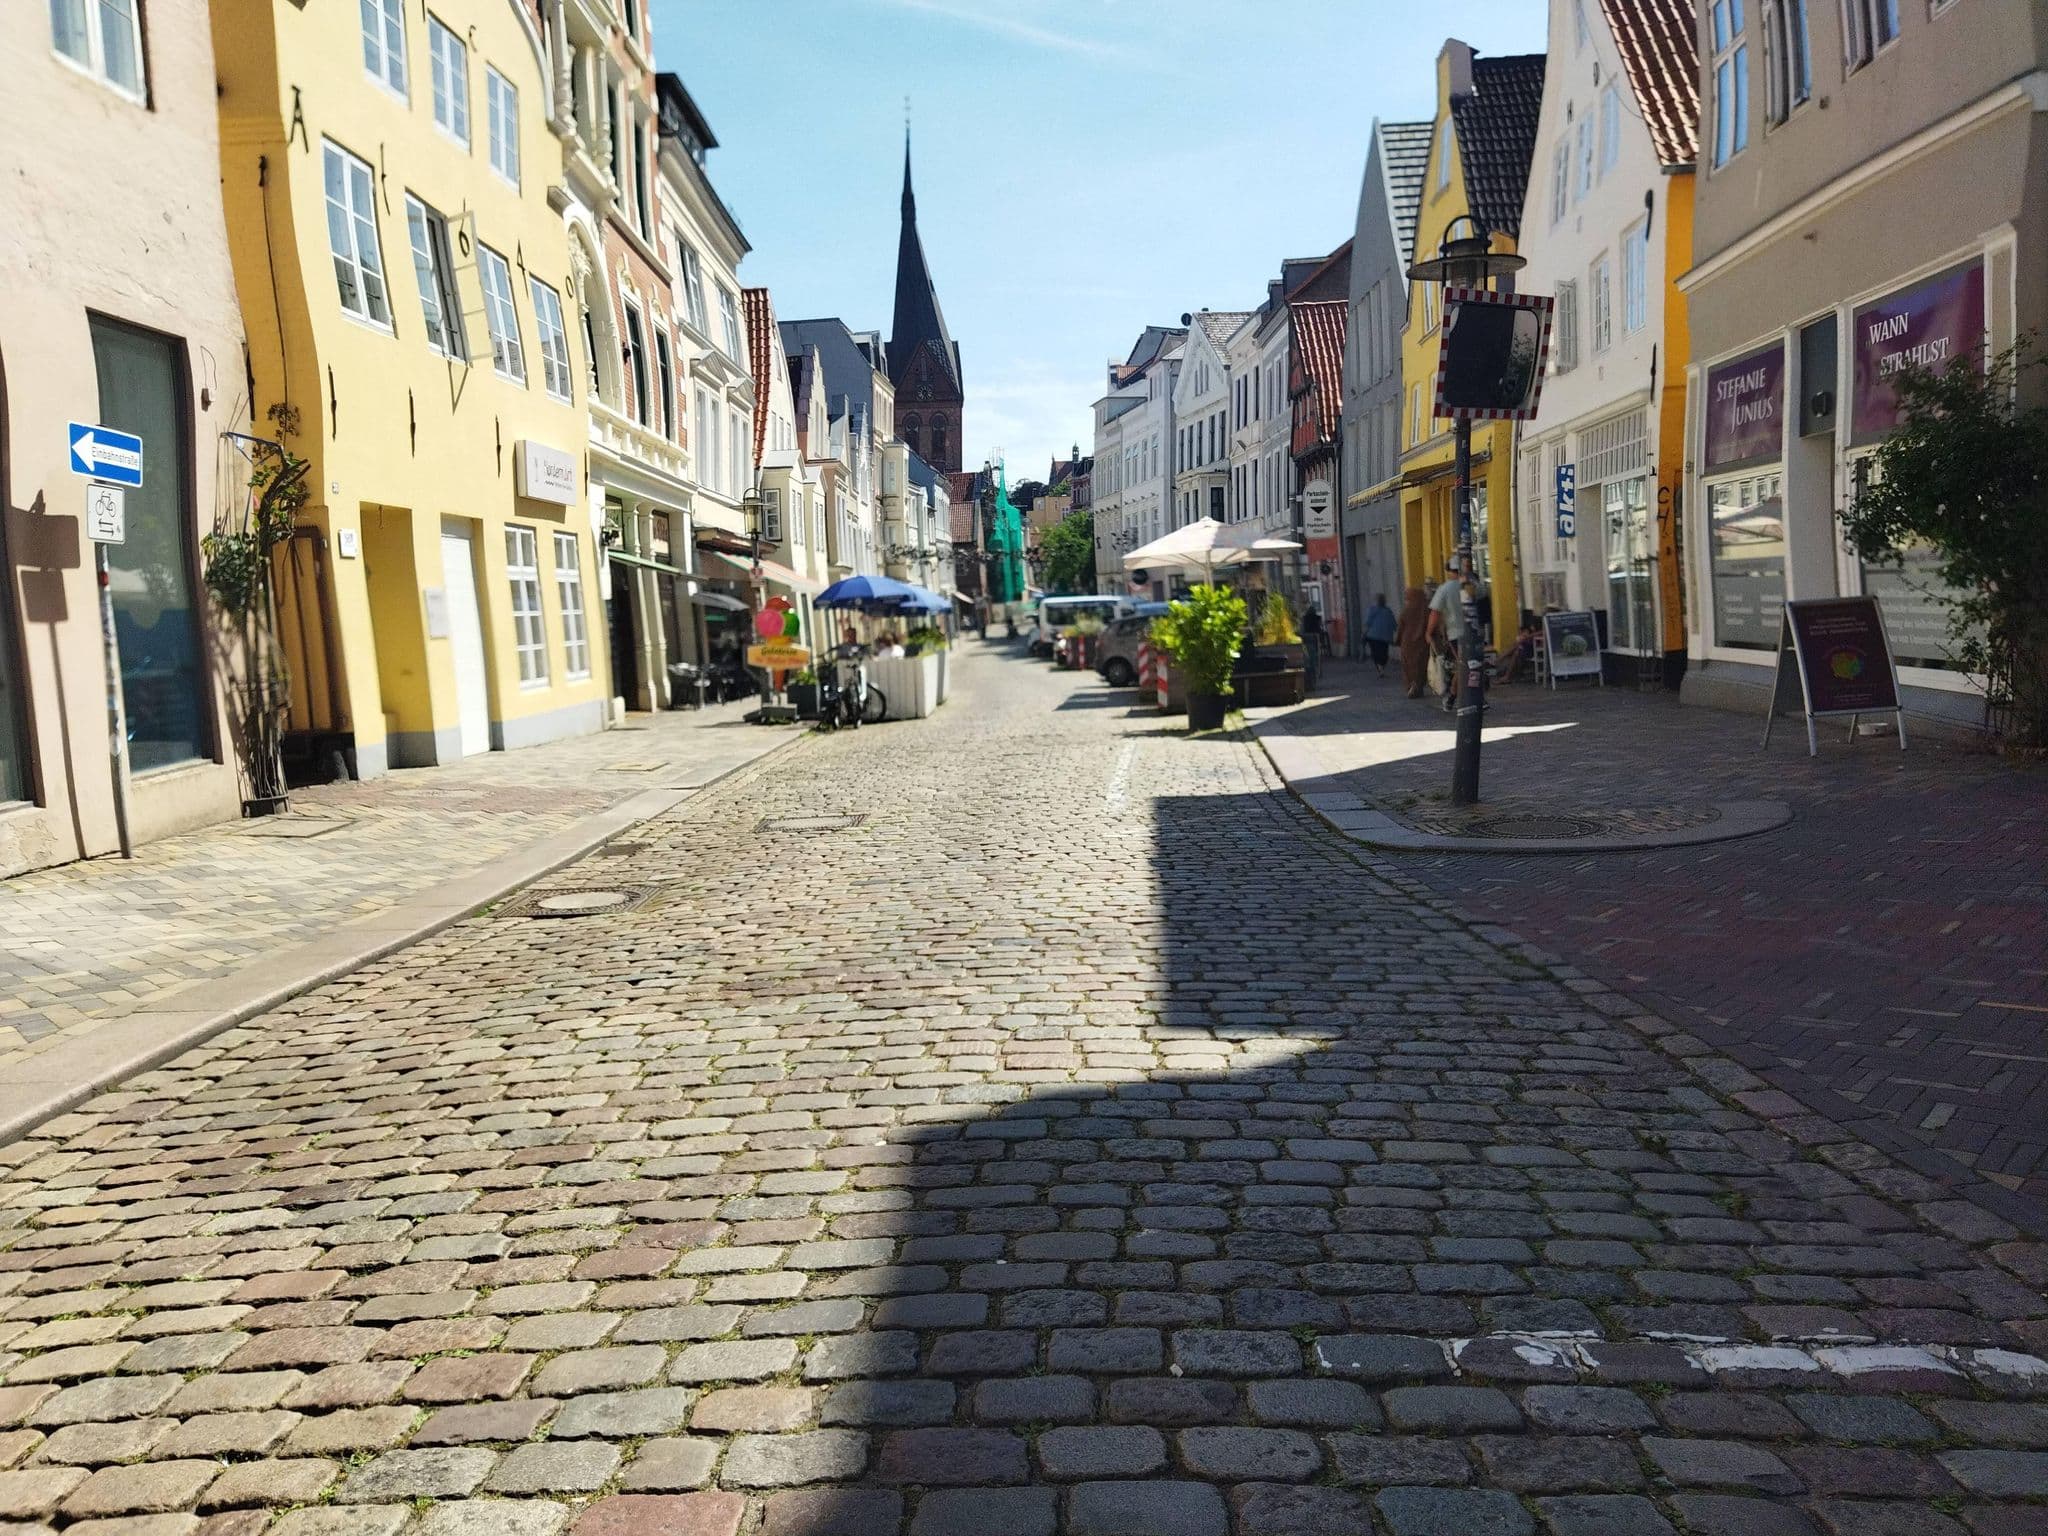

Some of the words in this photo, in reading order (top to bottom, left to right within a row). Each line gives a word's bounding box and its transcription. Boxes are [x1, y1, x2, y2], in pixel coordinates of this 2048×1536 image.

[1879, 337, 1950, 377] STRAHLST
[1716, 367, 1766, 402] STEFANIE
[1730, 395, 1774, 435] JUNIUS
[91, 445, 138, 467] Einbahnstraße
[1559, 467, 1575, 535] akt:
